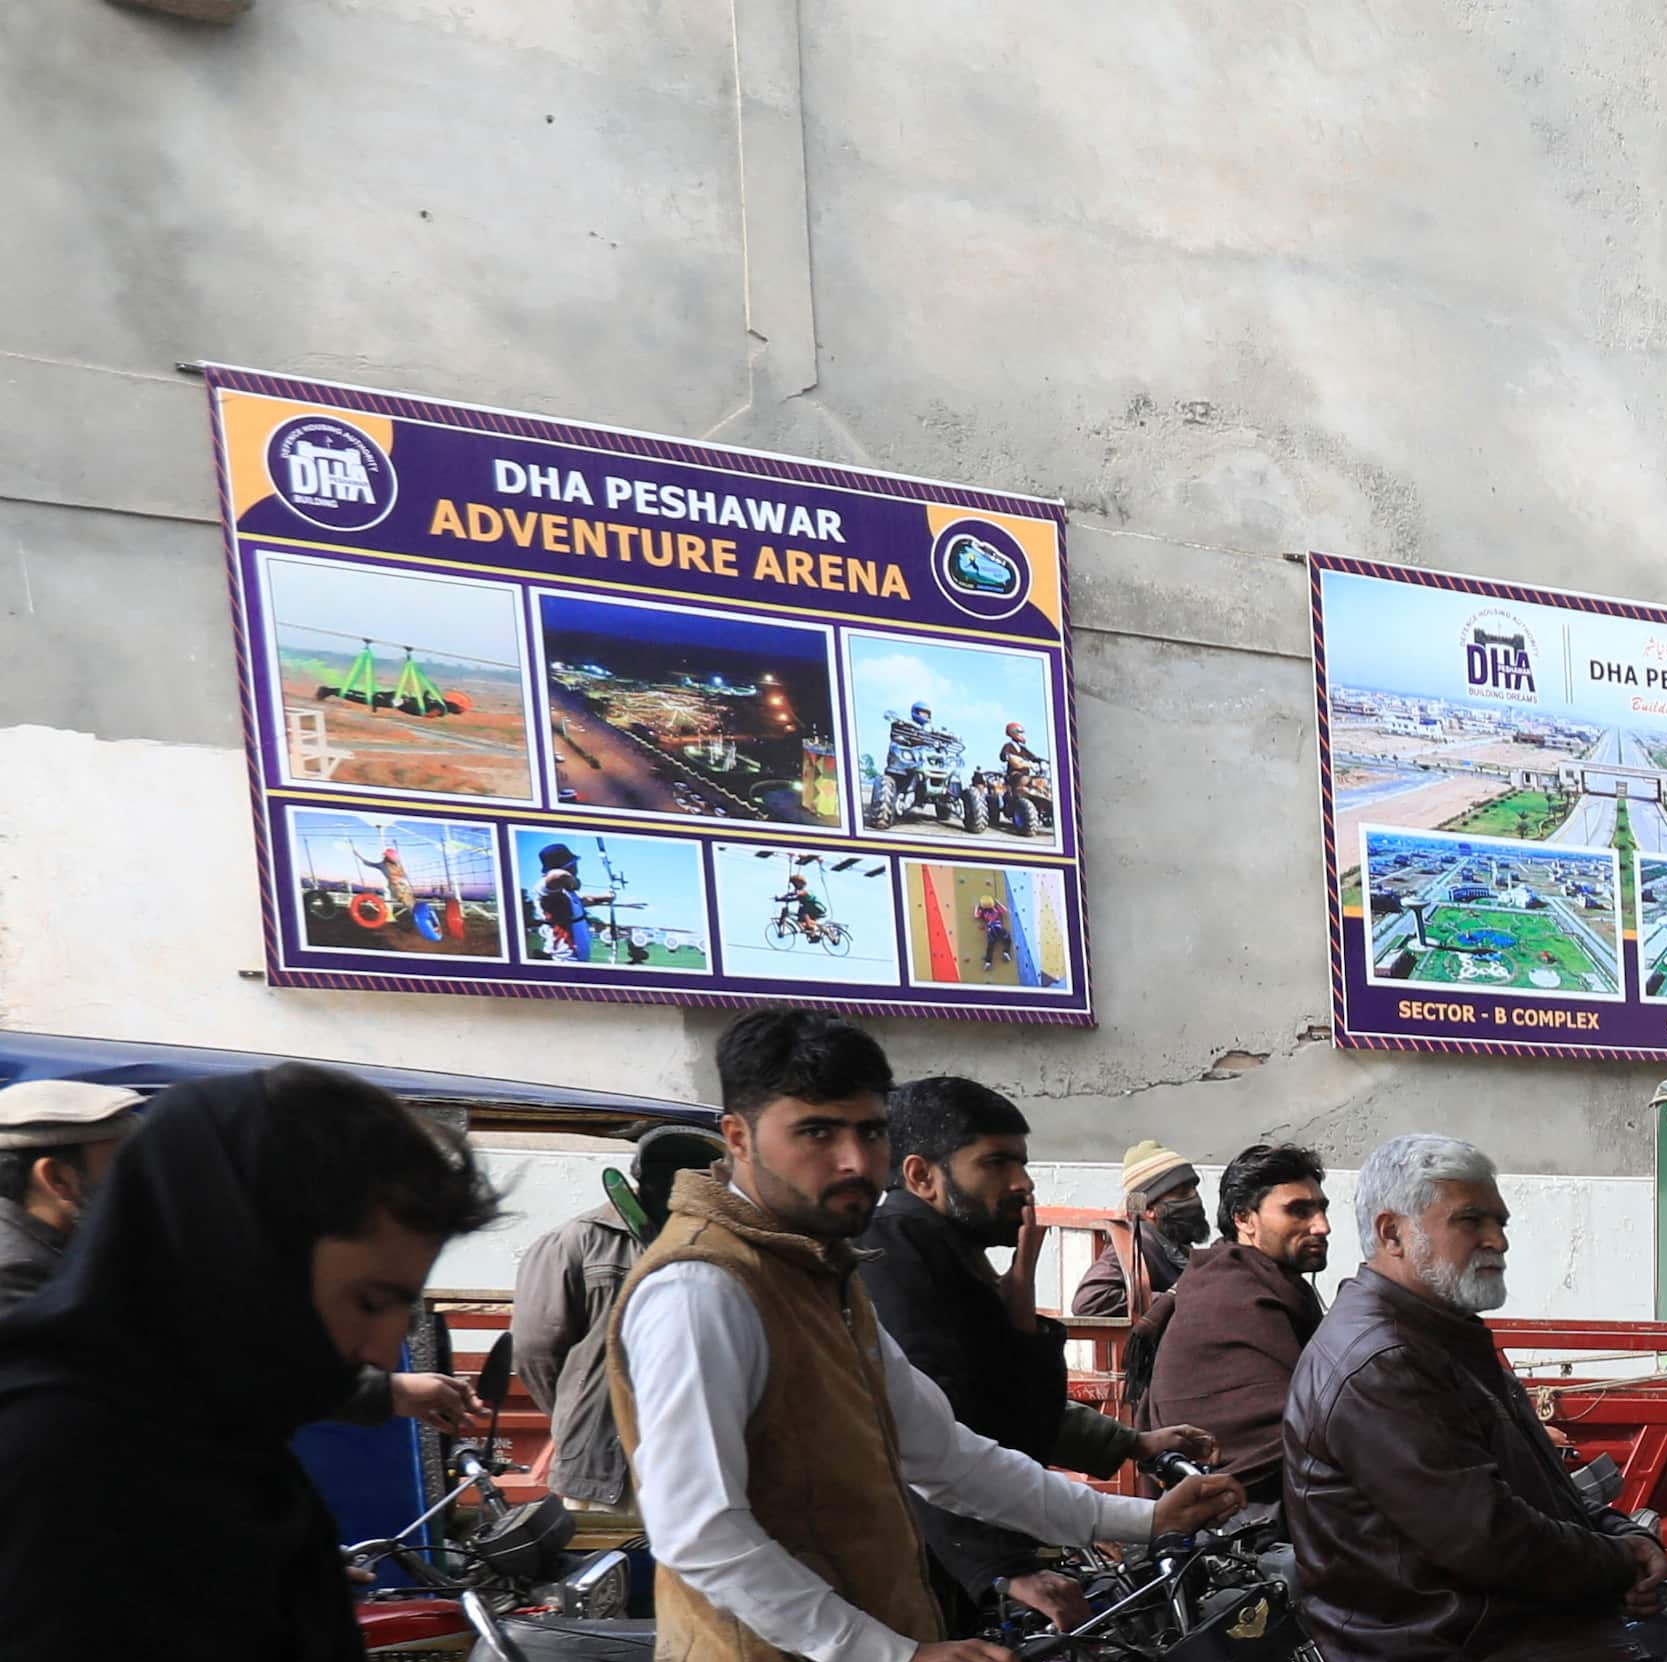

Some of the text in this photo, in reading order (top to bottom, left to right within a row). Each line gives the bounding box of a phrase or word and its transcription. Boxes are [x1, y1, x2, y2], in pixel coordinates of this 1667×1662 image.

[289, 454, 377, 504] DHA
[493, 459, 846, 544] DHA PESHAWAR
[429, 498, 911, 601] ADVENTURE ARENA
[1466, 644, 1536, 693] DHA
[1589, 659, 1638, 686] DHA
[1468, 687, 1538, 704] BUILDING DREAMS
[1398, 1000, 1475, 1023] SECTOR
[1495, 1007, 1507, 1025] B
[1512, 1007, 1600, 1030] COMPLEX
